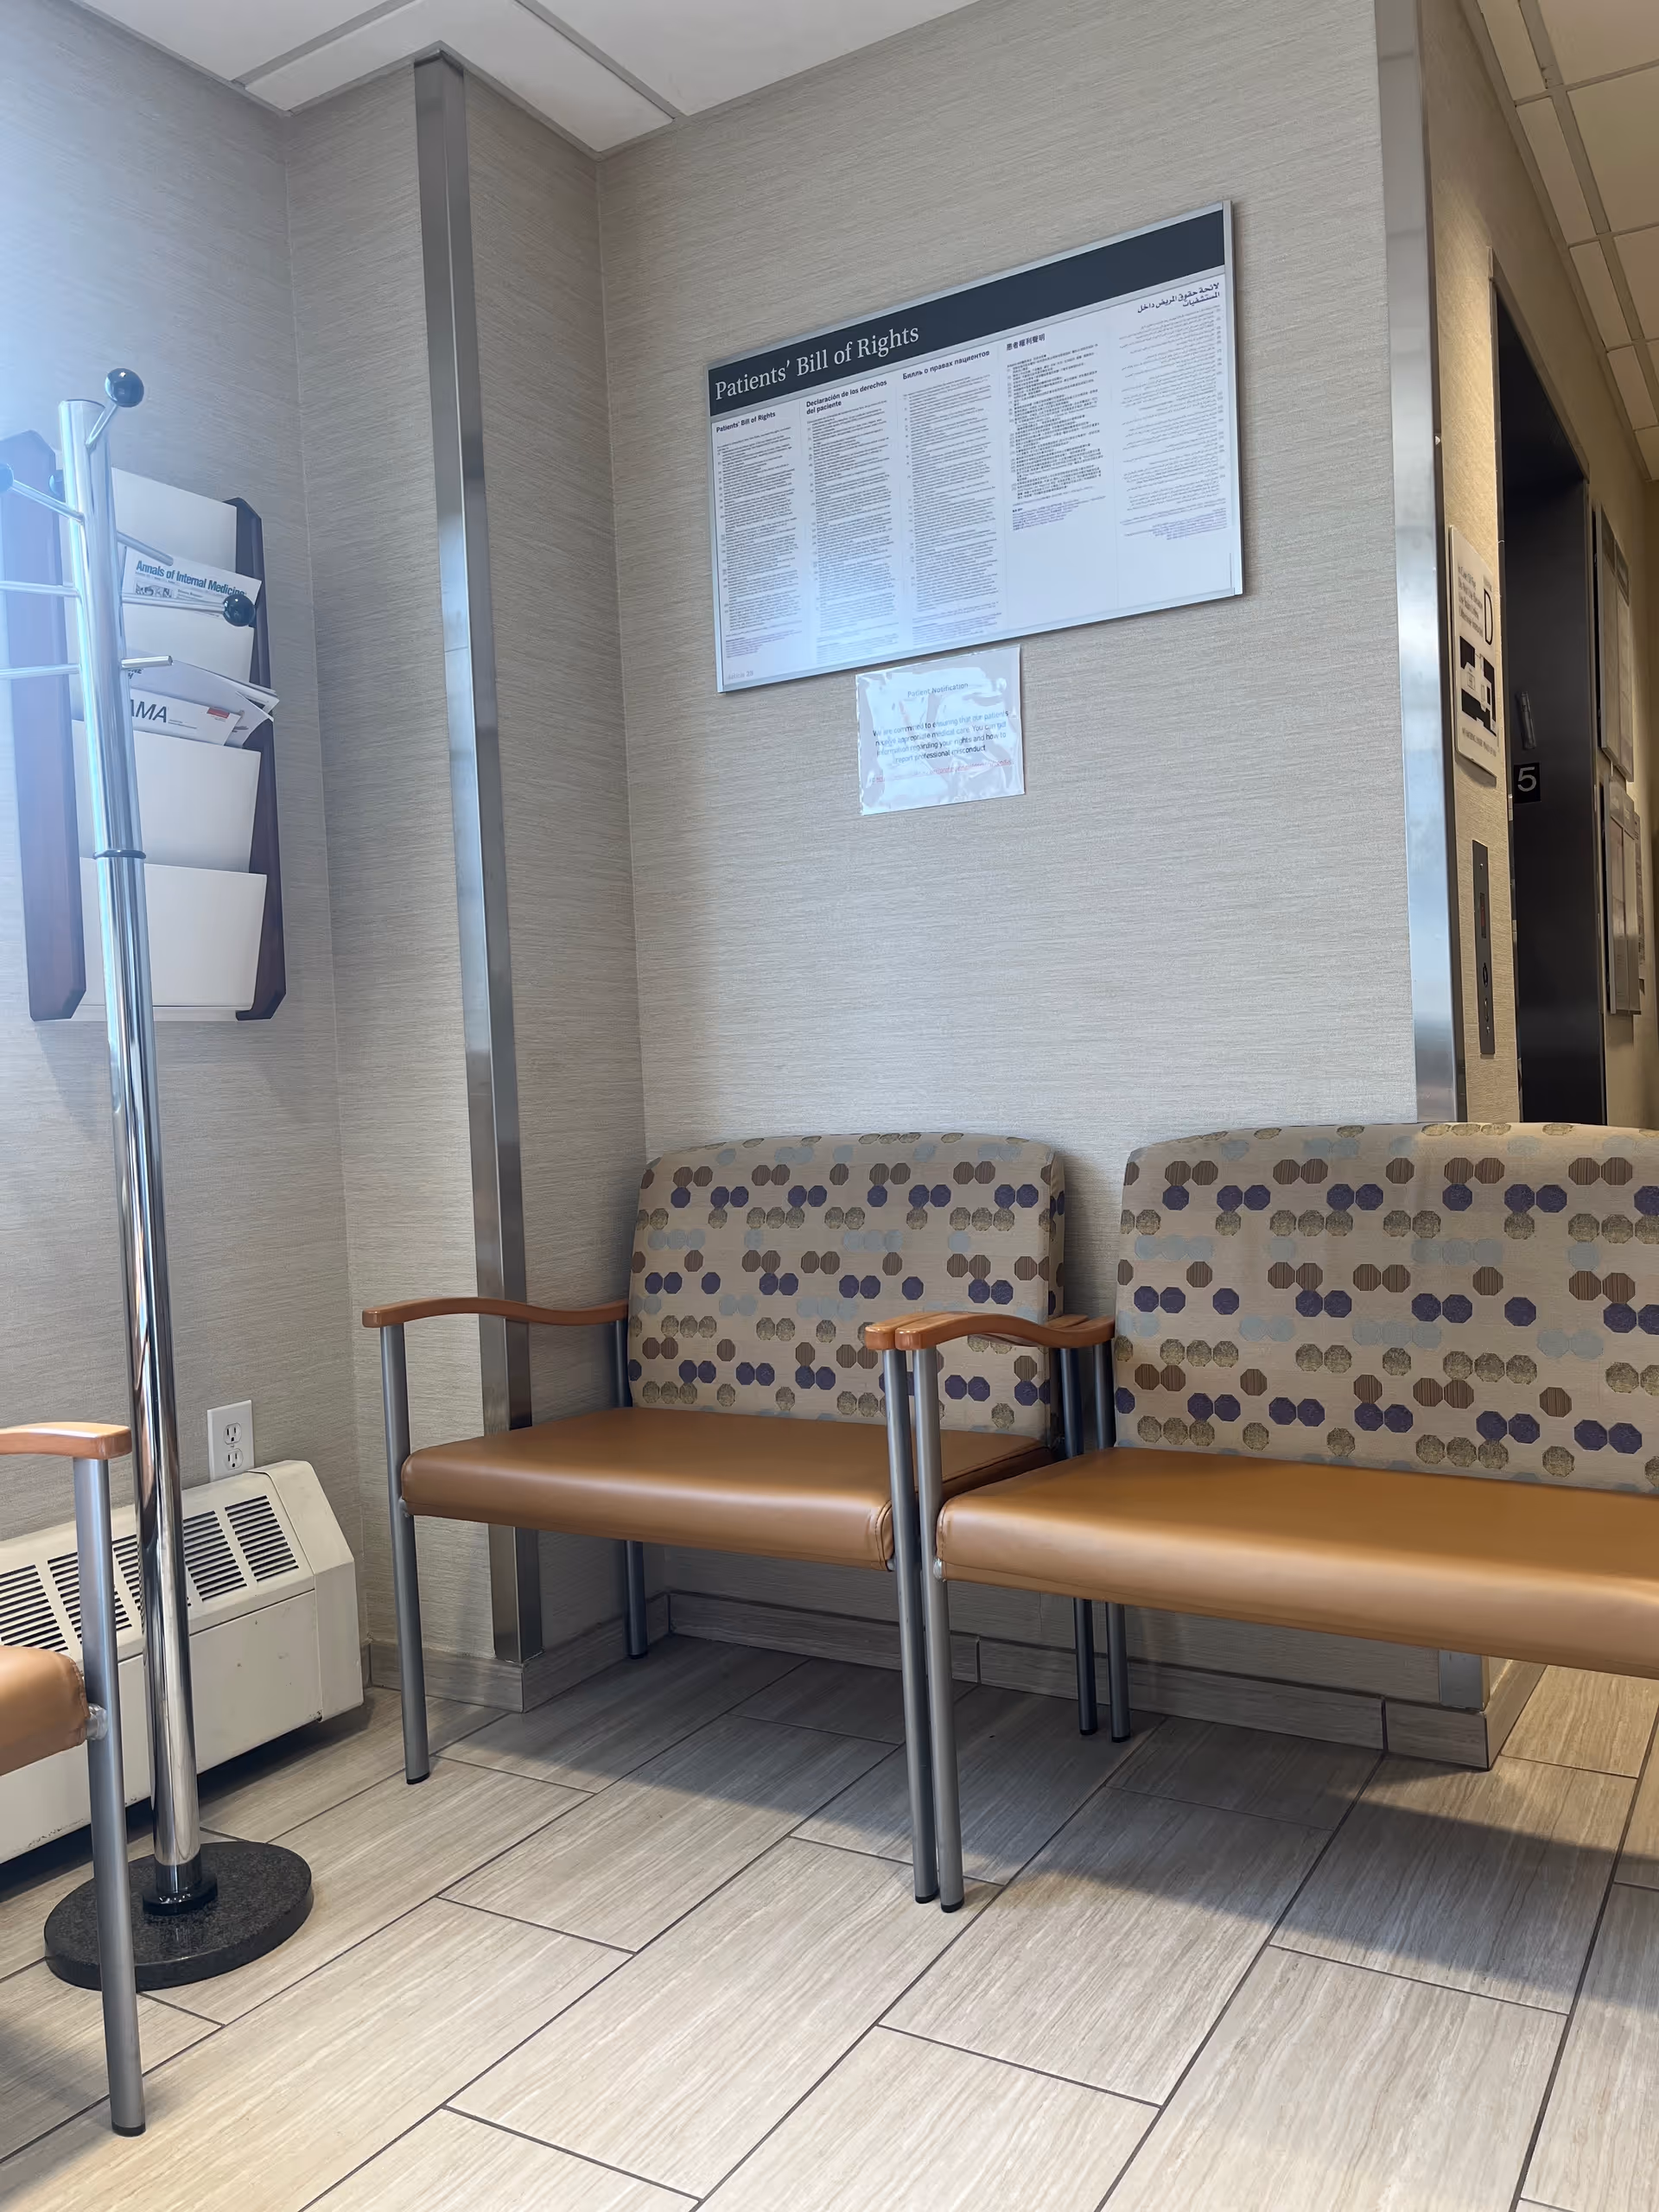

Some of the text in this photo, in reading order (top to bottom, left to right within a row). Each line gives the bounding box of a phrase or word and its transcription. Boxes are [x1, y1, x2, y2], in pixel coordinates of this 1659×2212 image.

[1155, 295, 1178, 308] المريض
[1178, 290, 1198, 302] حقوق
[715, 327, 920, 401] Patients’ Bill of Rights
[902, 369, 923, 380] Билль
[930, 360, 953, 372] правах
[954, 350, 990, 366] пациентов
[806, 393, 841, 408] Declaración
[841, 390, 849, 398] de
[860, 380, 887, 392] derechos
[806, 400, 842, 415] del paciente
[741, 416, 751, 427] Bill
[751, 415, 758, 423] of
[758, 411, 777, 422] Rights
[136, 560, 165, 577] Annals
[166, 569, 175, 580] of
[175, 571, 207, 589] Internal
[907, 683, 969, 698] Patient Notification
[959, 715, 971, 724] that
[910, 740, 938, 751] regarding
[939, 740, 952, 748] your
[954, 734, 972, 746] rights
[973, 734, 985, 743] and
[985, 732, 999, 741] how
[895, 754, 913, 764] report
[914, 749, 950, 762] professional
[1517, 766, 1537, 792] 5
